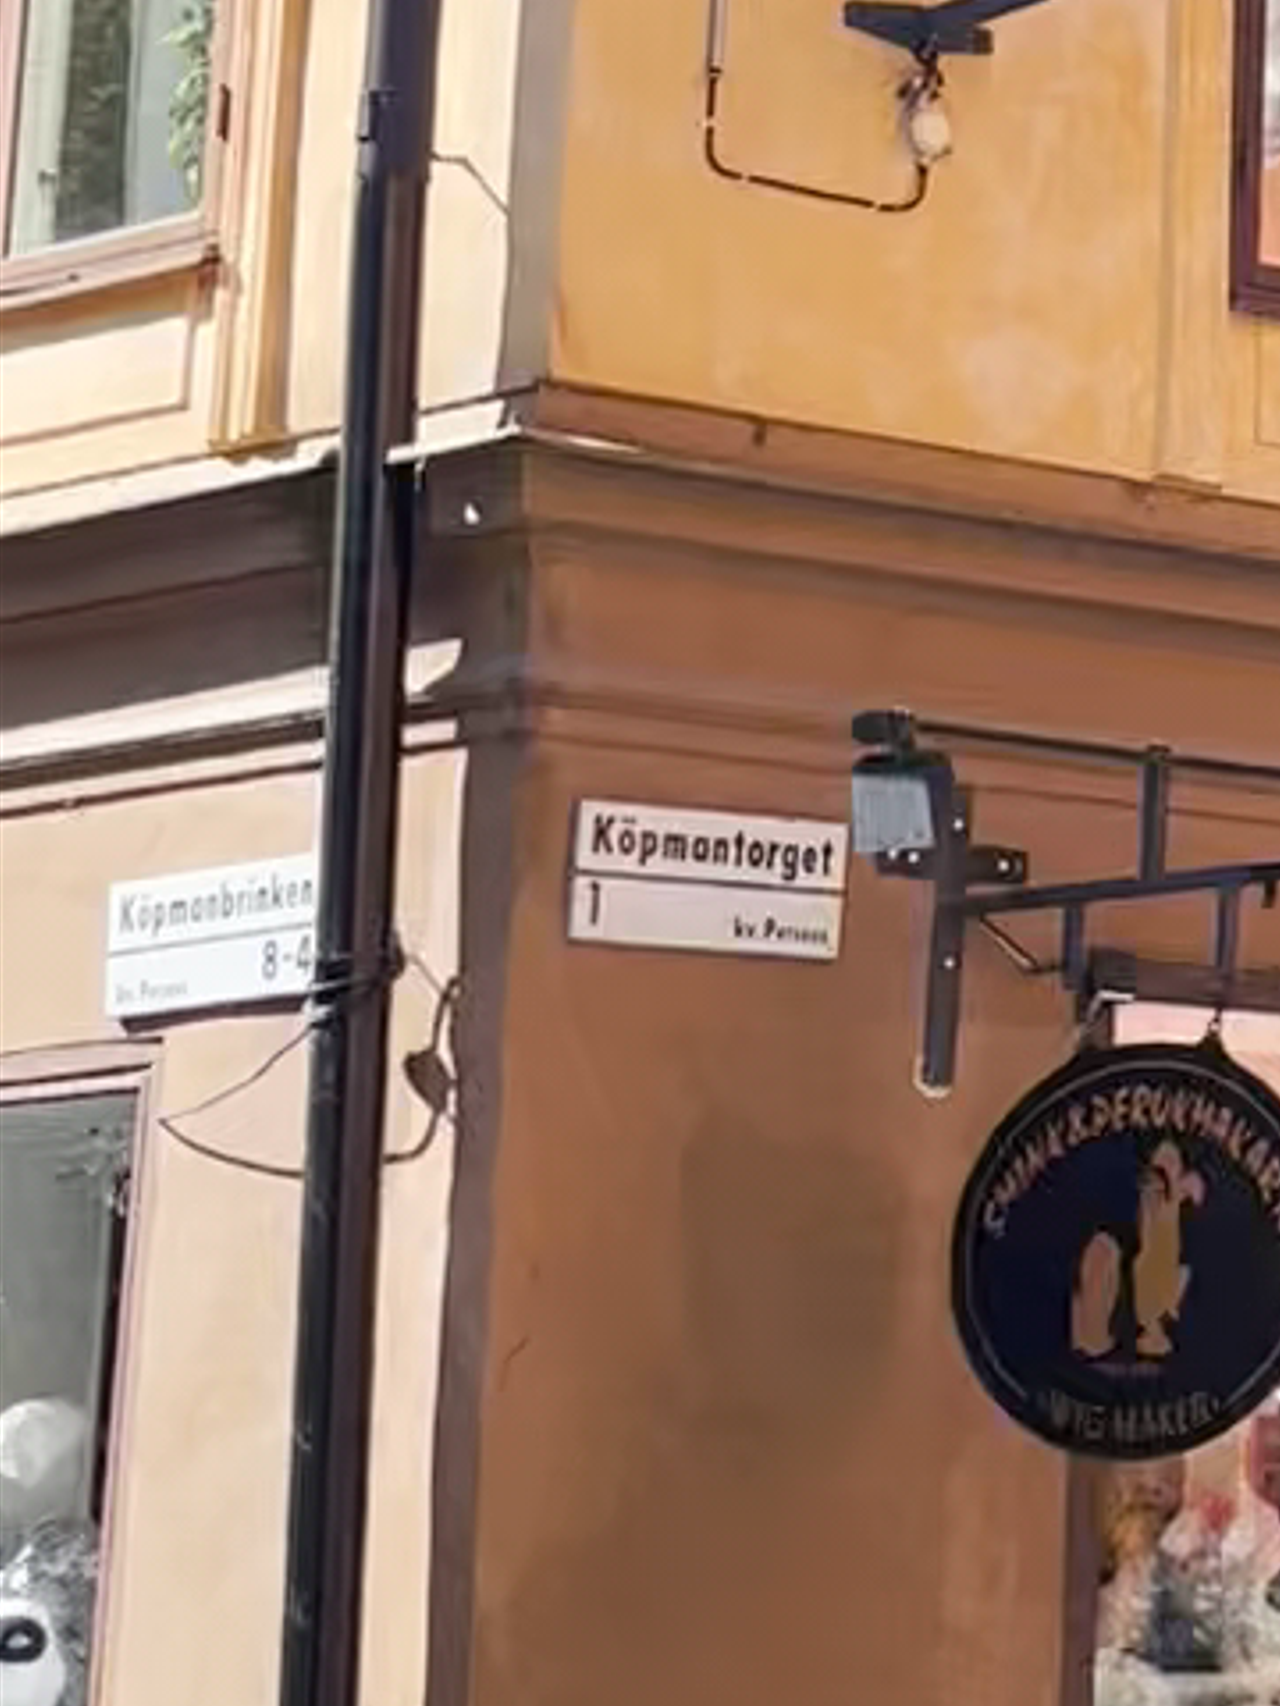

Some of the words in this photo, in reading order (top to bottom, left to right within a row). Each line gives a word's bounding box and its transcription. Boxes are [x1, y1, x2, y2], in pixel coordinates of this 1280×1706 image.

[592, 813, 833, 881] Köpmantorget
[119, 873, 313, 936] Köpmanbrinken
[590, 881, 600, 925] 1
